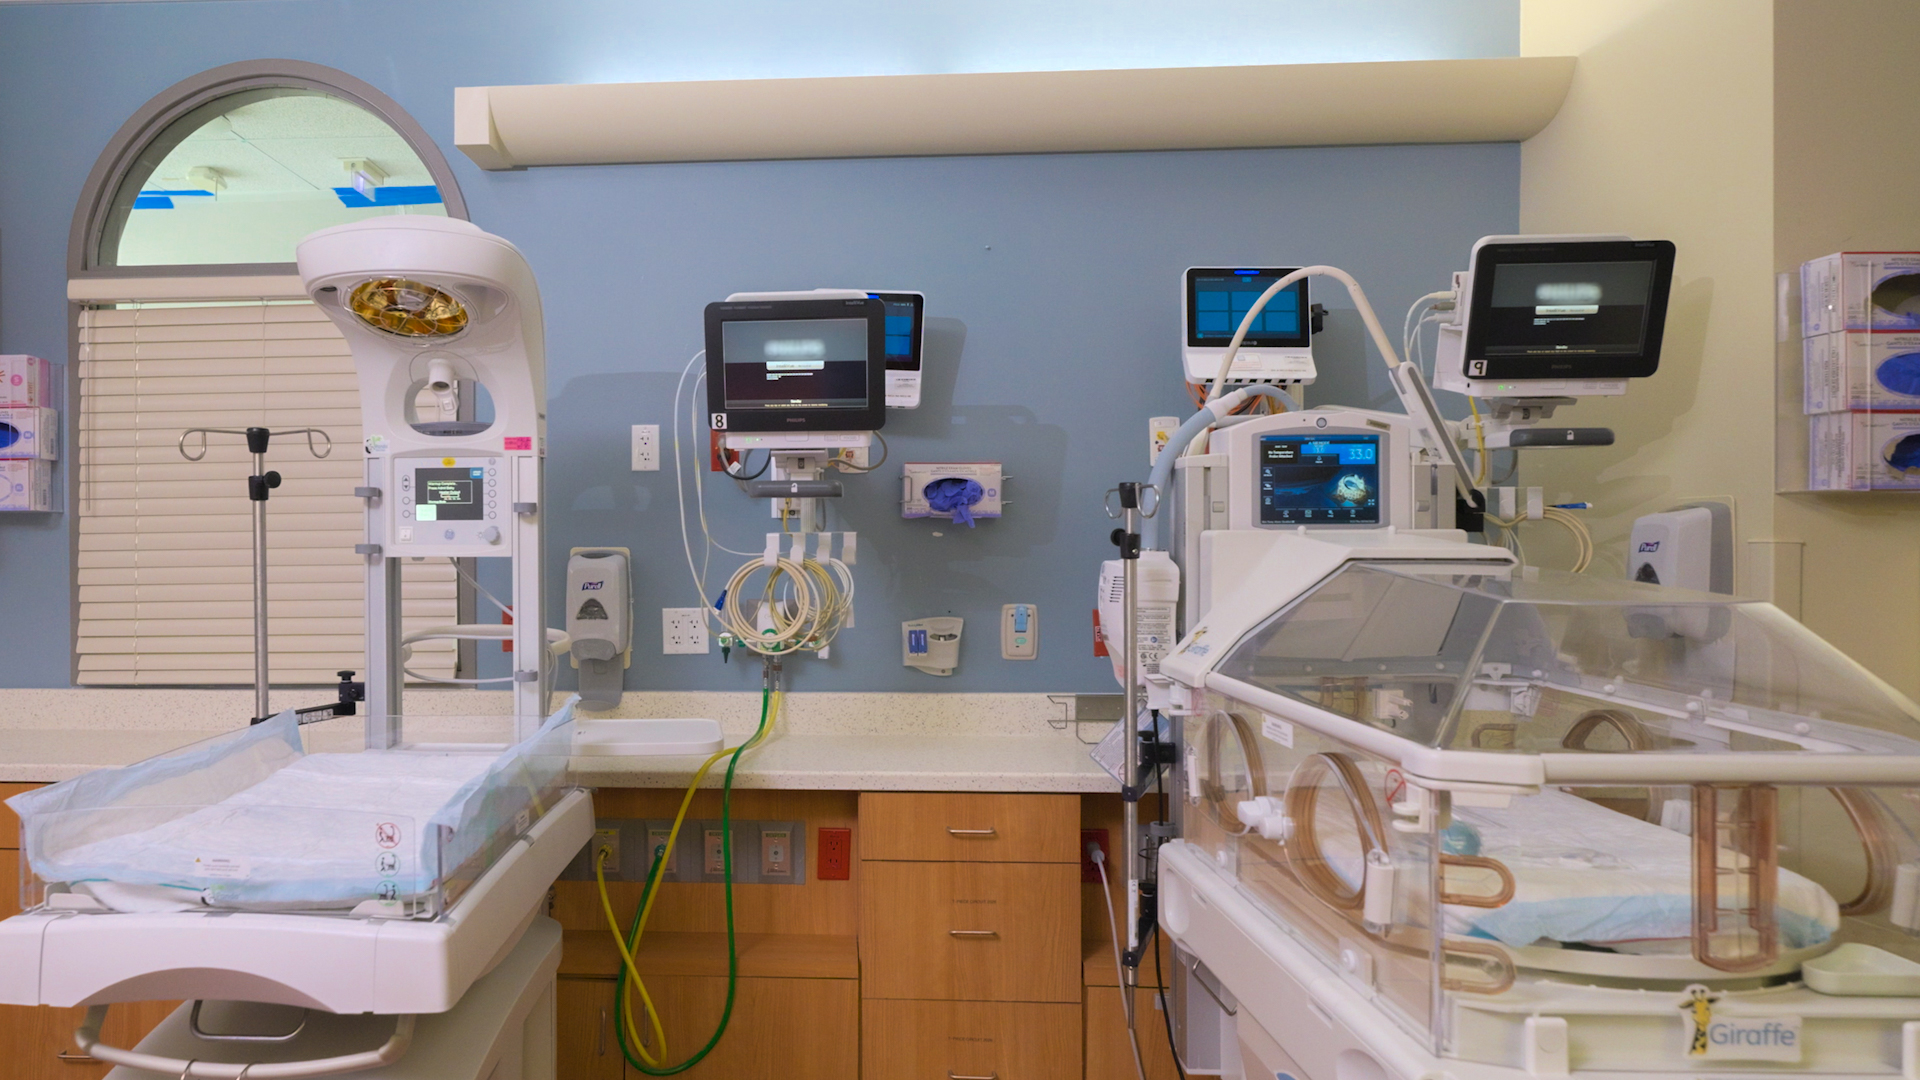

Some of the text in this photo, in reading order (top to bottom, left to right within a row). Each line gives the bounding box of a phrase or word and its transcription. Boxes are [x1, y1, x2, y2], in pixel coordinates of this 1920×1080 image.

[715, 414, 724, 428] 8
[1348, 448, 1373, 460] 33.0
[1710, 1022, 1796, 1047] Giraffe
